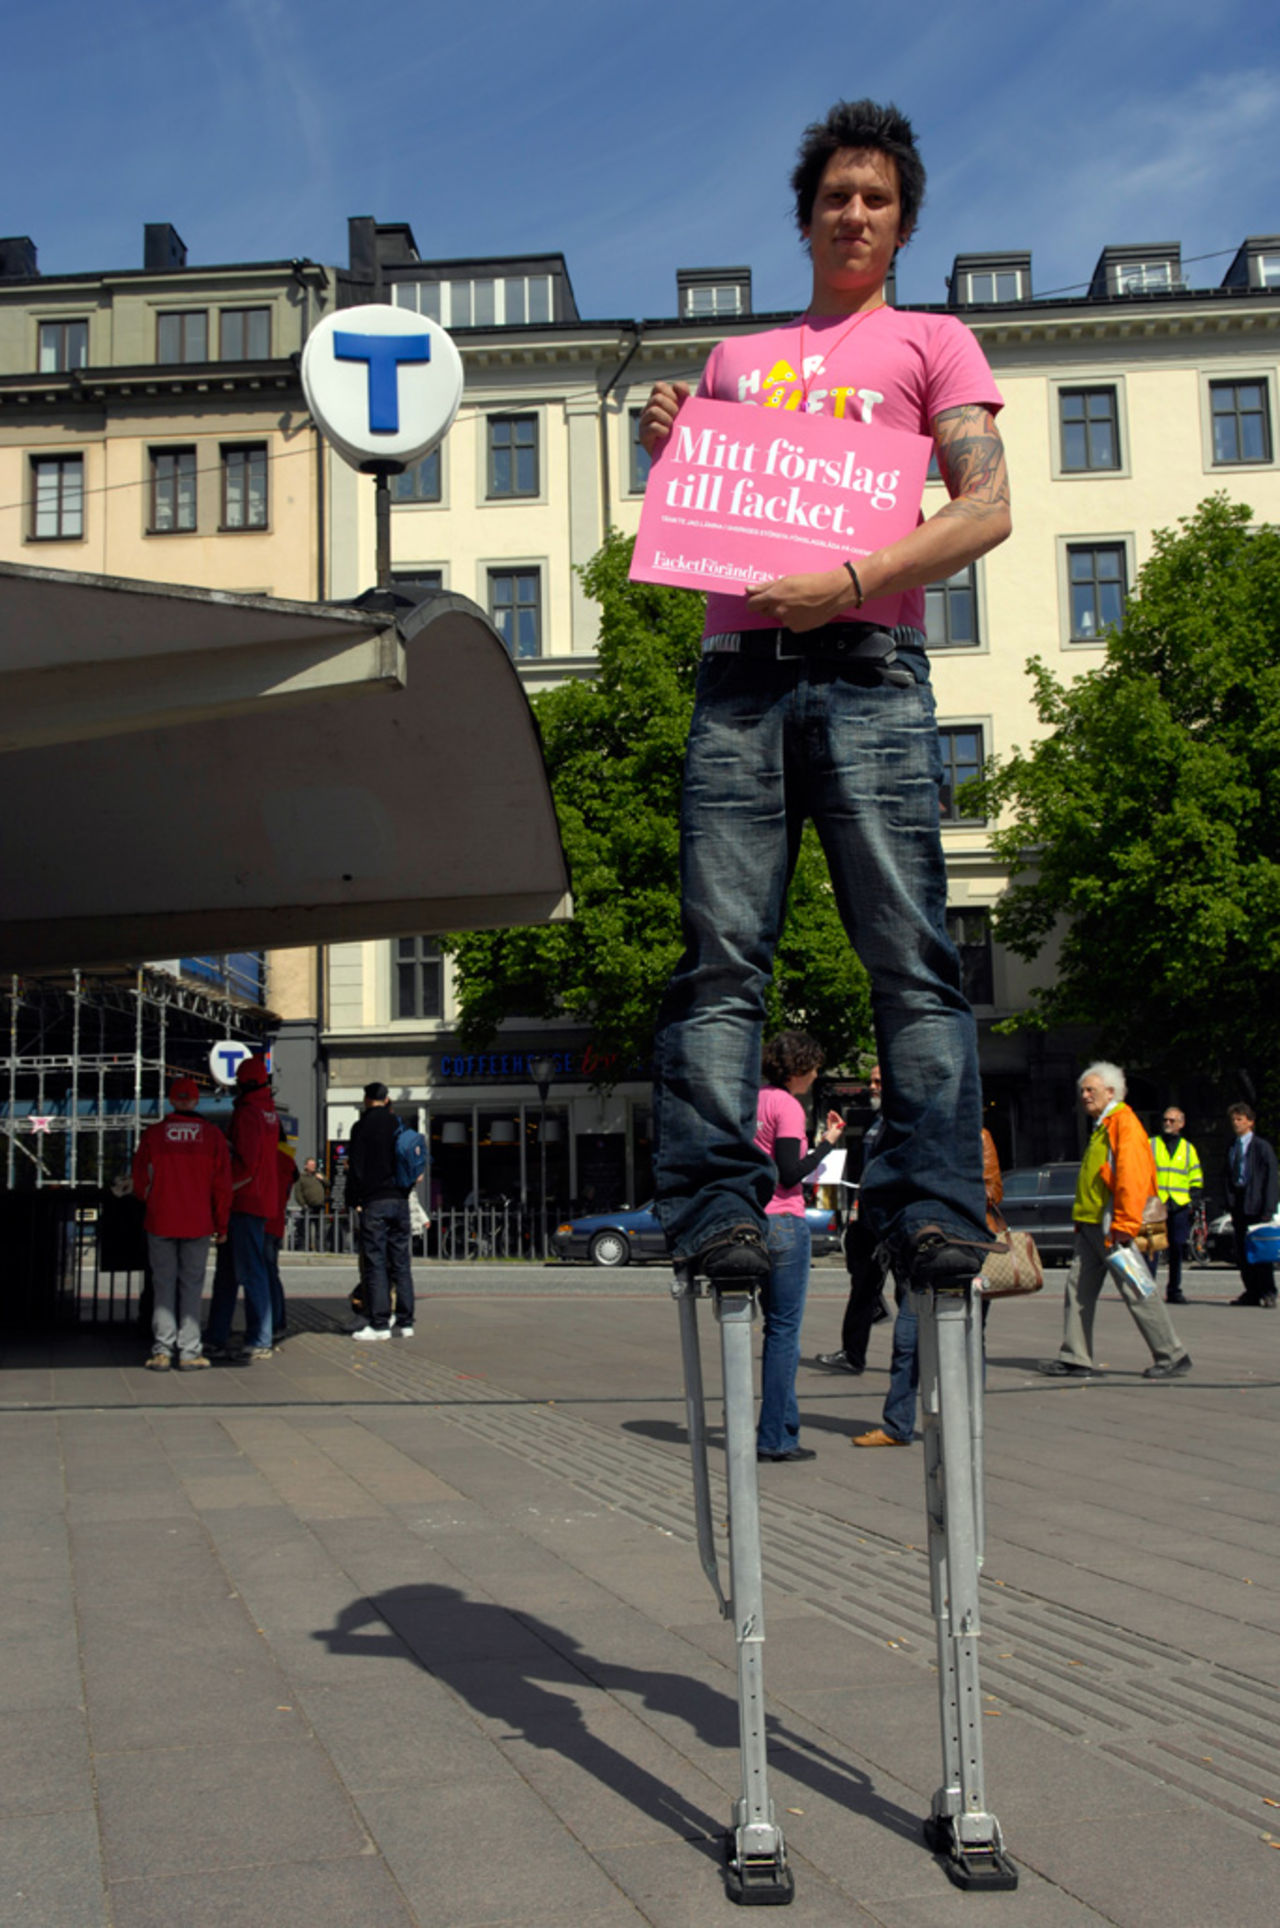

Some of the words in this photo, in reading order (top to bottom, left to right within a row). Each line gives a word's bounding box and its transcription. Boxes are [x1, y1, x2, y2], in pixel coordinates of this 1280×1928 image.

[333, 331, 431, 433] T
[738, 354, 826, 401] HAR
[670, 425, 760, 472] Mitt
[761, 438, 900, 511] förslag
[666, 473, 724, 513] till
[728, 477, 855, 536] facket.
[218, 1051, 244, 1078] T
[441, 1052, 573, 1077] COFFEEHOSE
[167, 1128, 199, 1141] CITY
